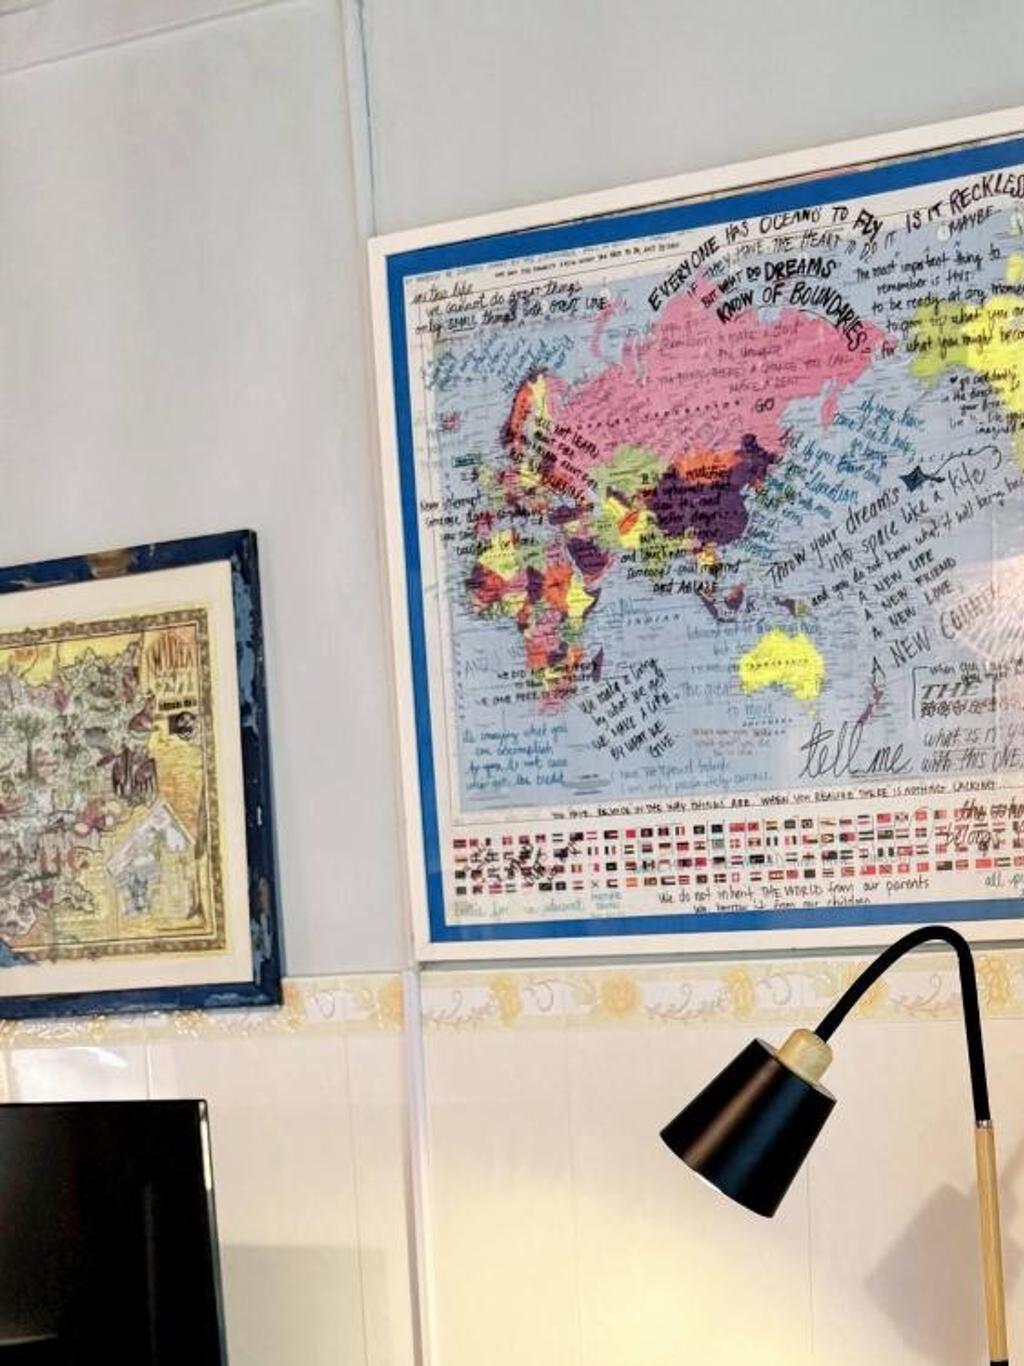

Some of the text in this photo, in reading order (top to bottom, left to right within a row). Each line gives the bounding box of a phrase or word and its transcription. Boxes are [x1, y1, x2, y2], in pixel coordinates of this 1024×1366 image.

[906, 212, 922, 233] IS
[927, 200, 943, 222] IT
[949, 205, 996, 234] MAYBE
[648, 235, 721, 312] EVERYONE
[725, 220, 750, 243] HAS
[832, 207, 849, 223] TO
[853, 209, 883, 241] FLY
[763, 258, 837, 281] DREAMS
[716, 281, 867, 352] KNOW OF BOUNDARIES
[864, 558, 957, 620] A NEW FRIEND
[873, 570, 902, 591] NEW
[908, 550, 934, 571] LIFE
[888, 607, 916, 626] NEW
[890, 626, 931, 668] NEW
[800, 721, 913, 778] tell me
